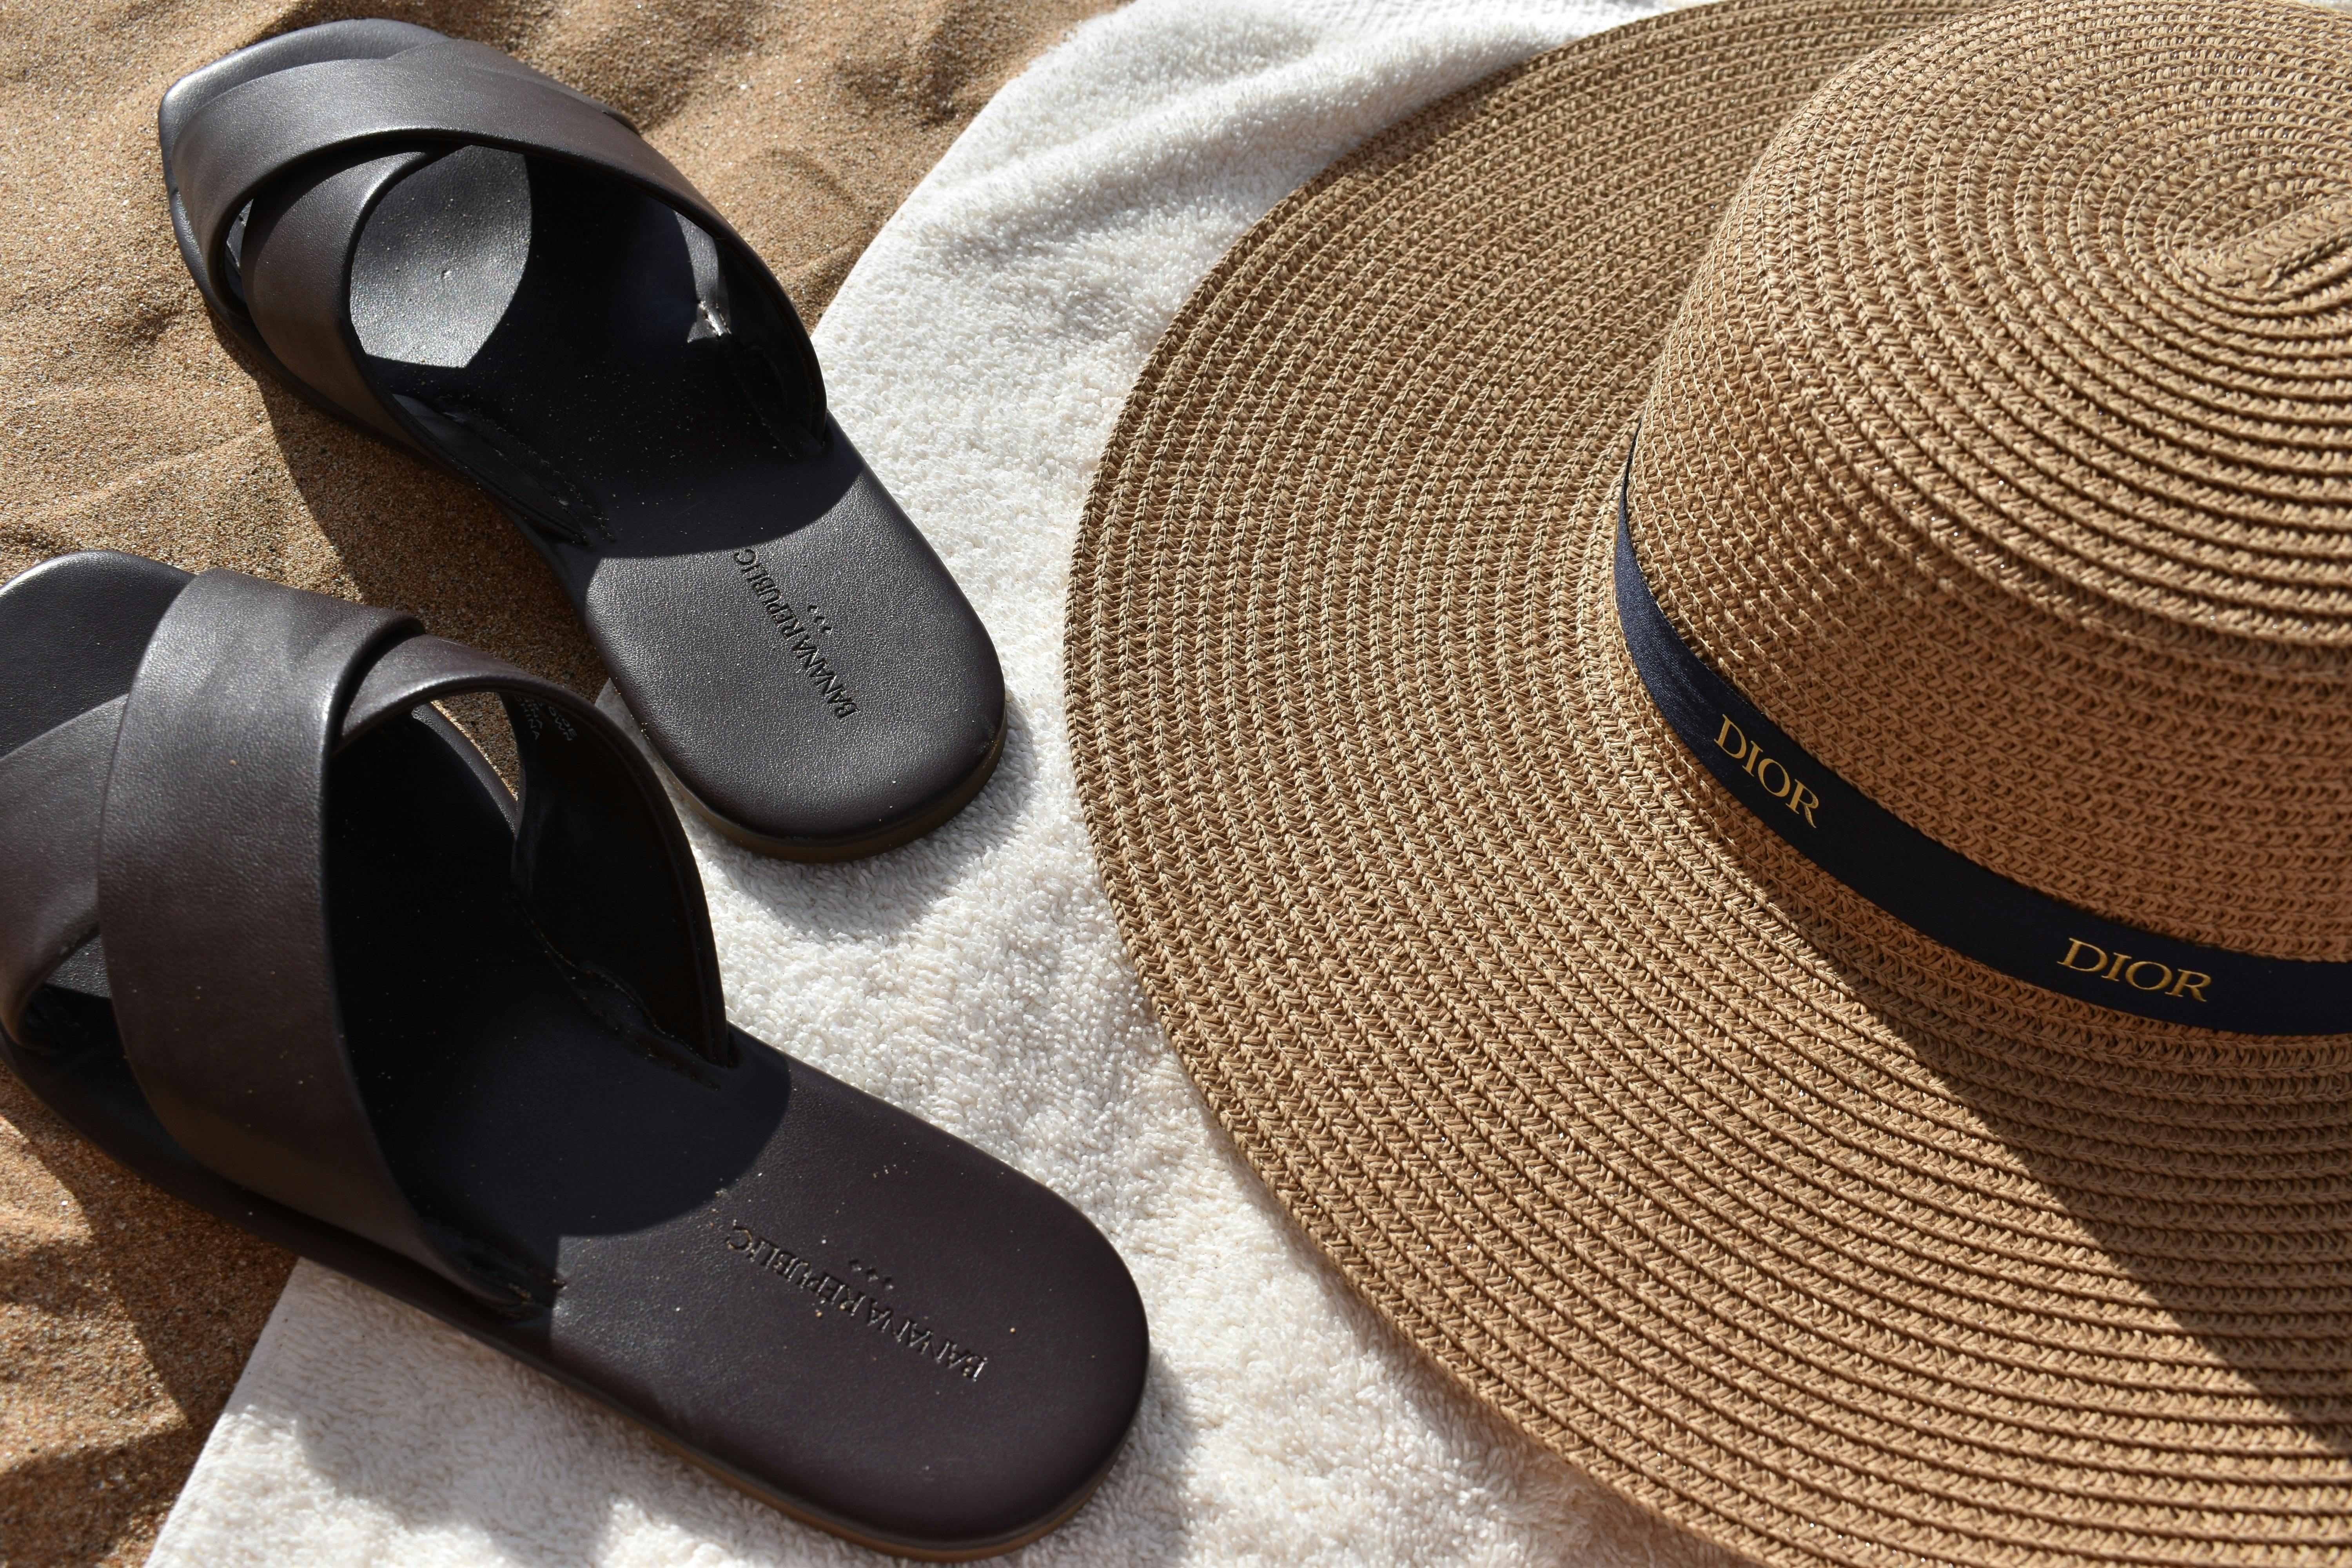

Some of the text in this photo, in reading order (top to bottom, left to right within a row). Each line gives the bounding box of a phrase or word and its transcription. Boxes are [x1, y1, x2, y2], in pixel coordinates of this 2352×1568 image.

[734, 549, 860, 719] BANANA REPUBLIC
[1713, 713, 1819, 828] DIOR
[2056, 937, 2212, 1002] DIOR
[725, 1221, 987, 1381] BANANA REPUBLIC
